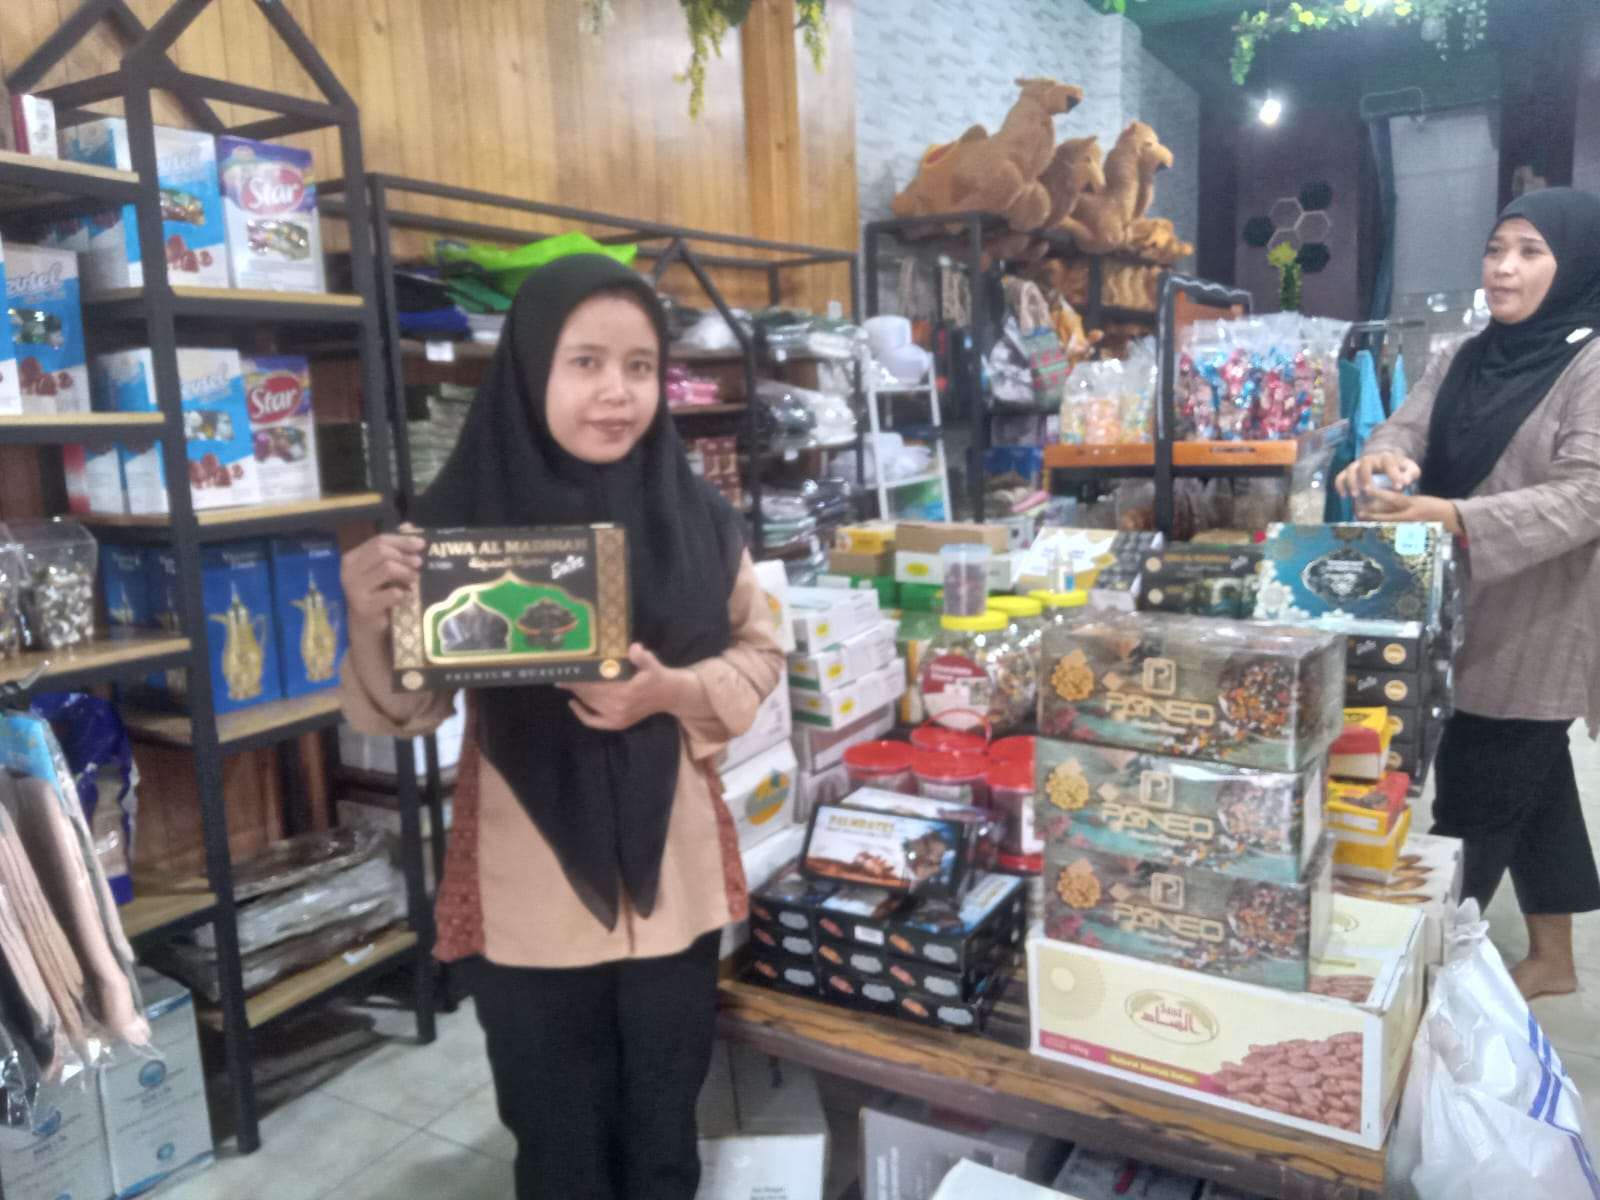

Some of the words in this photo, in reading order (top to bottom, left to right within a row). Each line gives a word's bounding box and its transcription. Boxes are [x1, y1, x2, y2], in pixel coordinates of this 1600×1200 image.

[248, 177, 300, 208] Star
[251, 387, 297, 419] Star
[428, 541, 475, 559] AJWA
[479, 540, 502, 554] AL
[505, 538, 588, 554] MADINAH
[444, 670, 513, 682] PREMIUM
[519, 666, 582, 679] QUALITY
